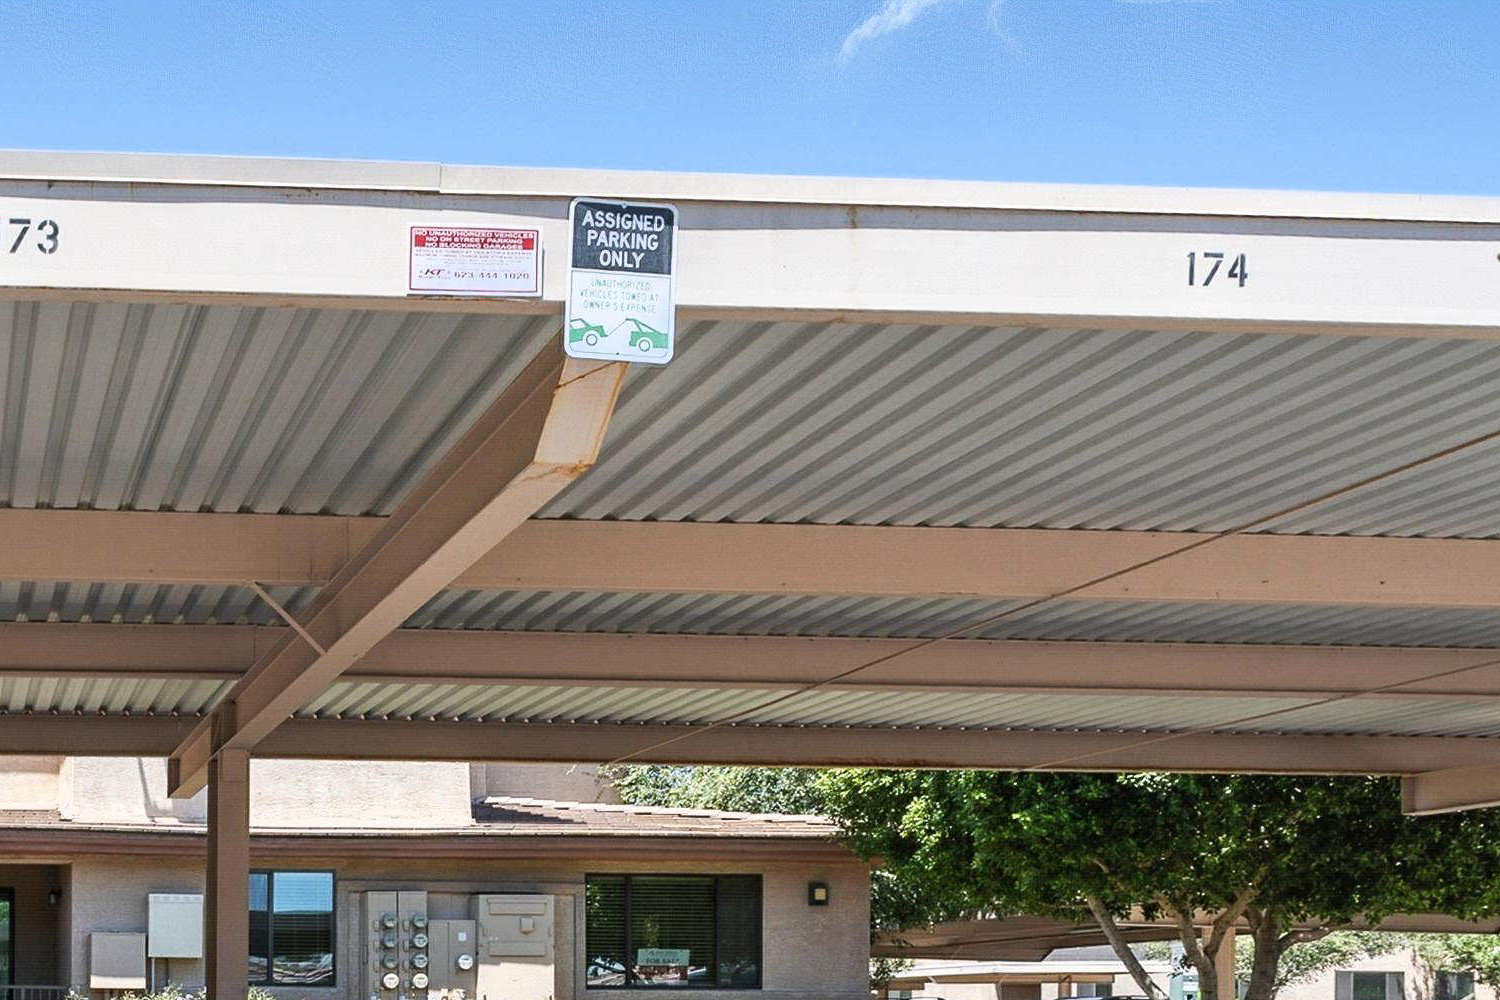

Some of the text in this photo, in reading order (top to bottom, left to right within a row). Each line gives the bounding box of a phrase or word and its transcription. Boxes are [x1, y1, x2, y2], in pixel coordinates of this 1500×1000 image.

[582, 210, 665, 232] ASSIGNED
[429, 230, 493, 238] UNAUTHORIZED
[494, 231, 534, 239] VEHICLES
[587, 229, 659, 251] PARKING
[599, 249, 645, 268] ONLY
[1187, 252, 1248, 288] 174
[590, 279, 651, 291] UNAUTHORIZED
[580, 288, 660, 302] VEHICLES TOWED AT
[620, 302, 657, 314] EXPENSE
